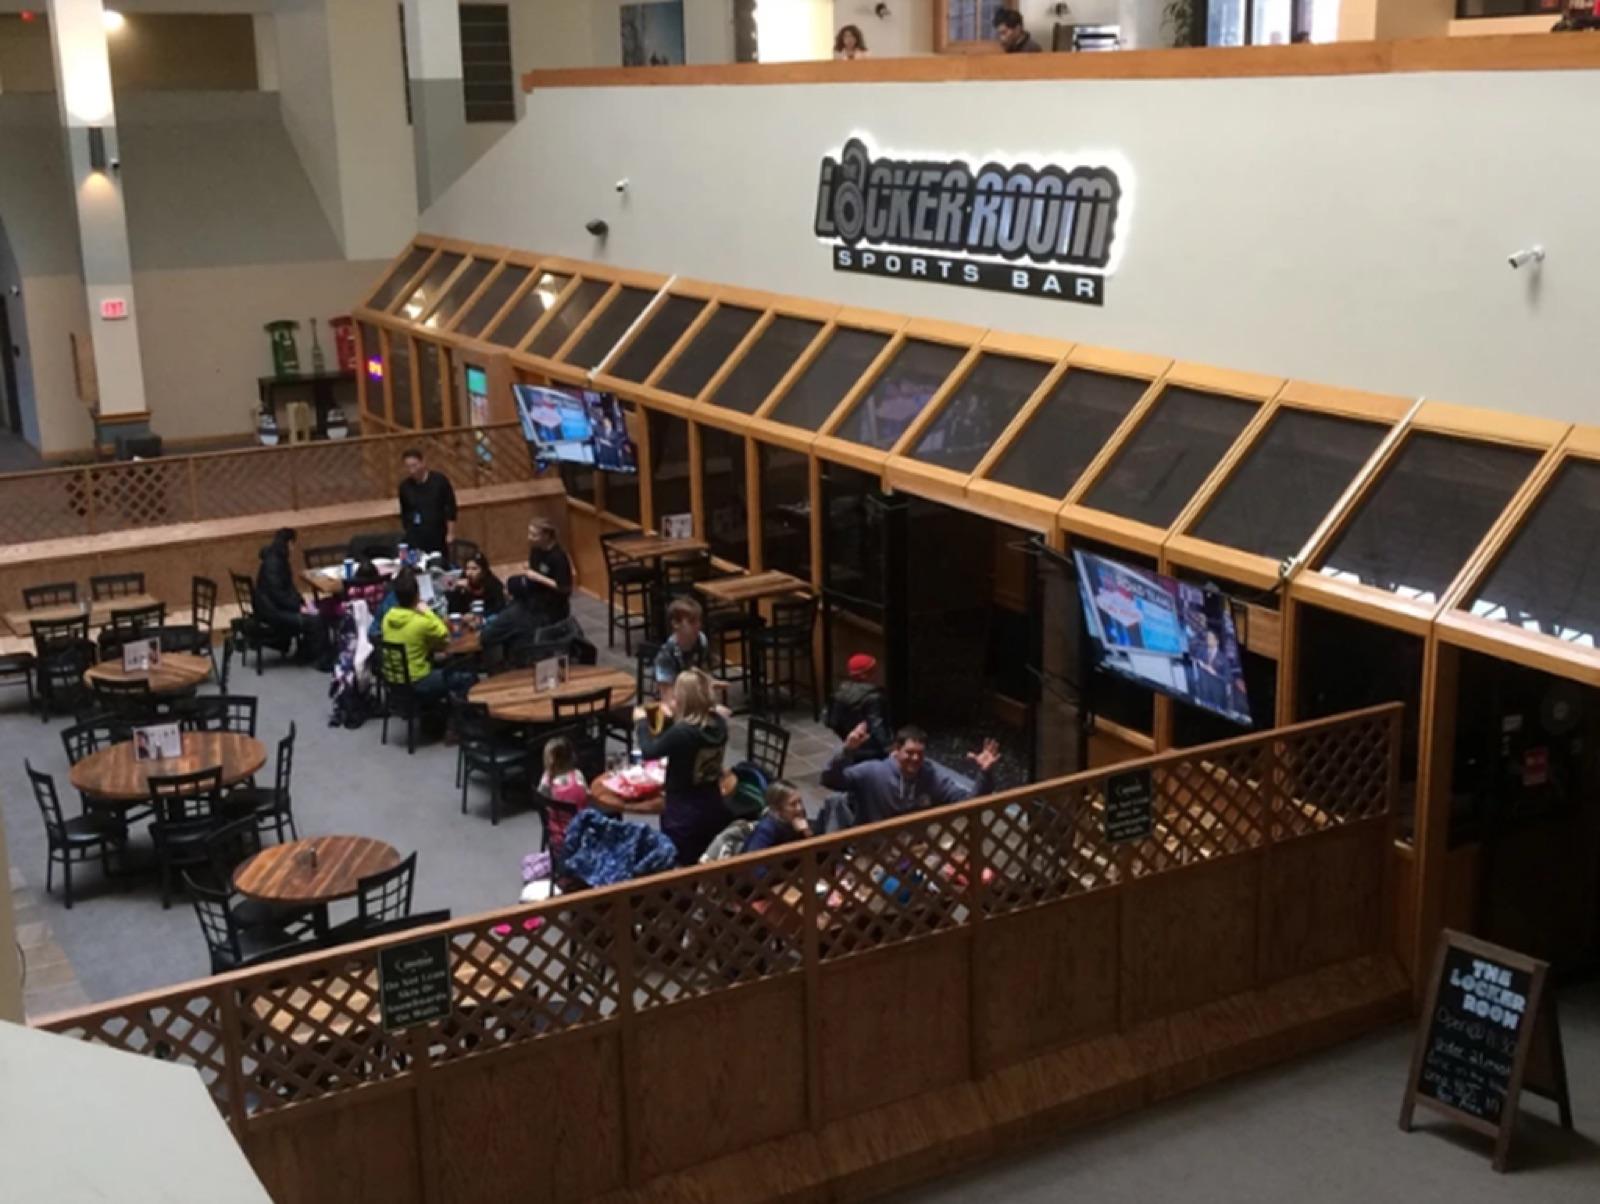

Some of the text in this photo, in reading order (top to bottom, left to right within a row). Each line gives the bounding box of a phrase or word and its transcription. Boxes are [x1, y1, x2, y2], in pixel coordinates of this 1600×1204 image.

[816, 146, 1113, 258] LOCKER ROOM
[838, 248, 1095, 298] SPORTS BAR
[1450, 968, 1526, 1013] LOCKER
[1472, 959, 1513, 987] THE
[1462, 994, 1520, 1030] ROOM
